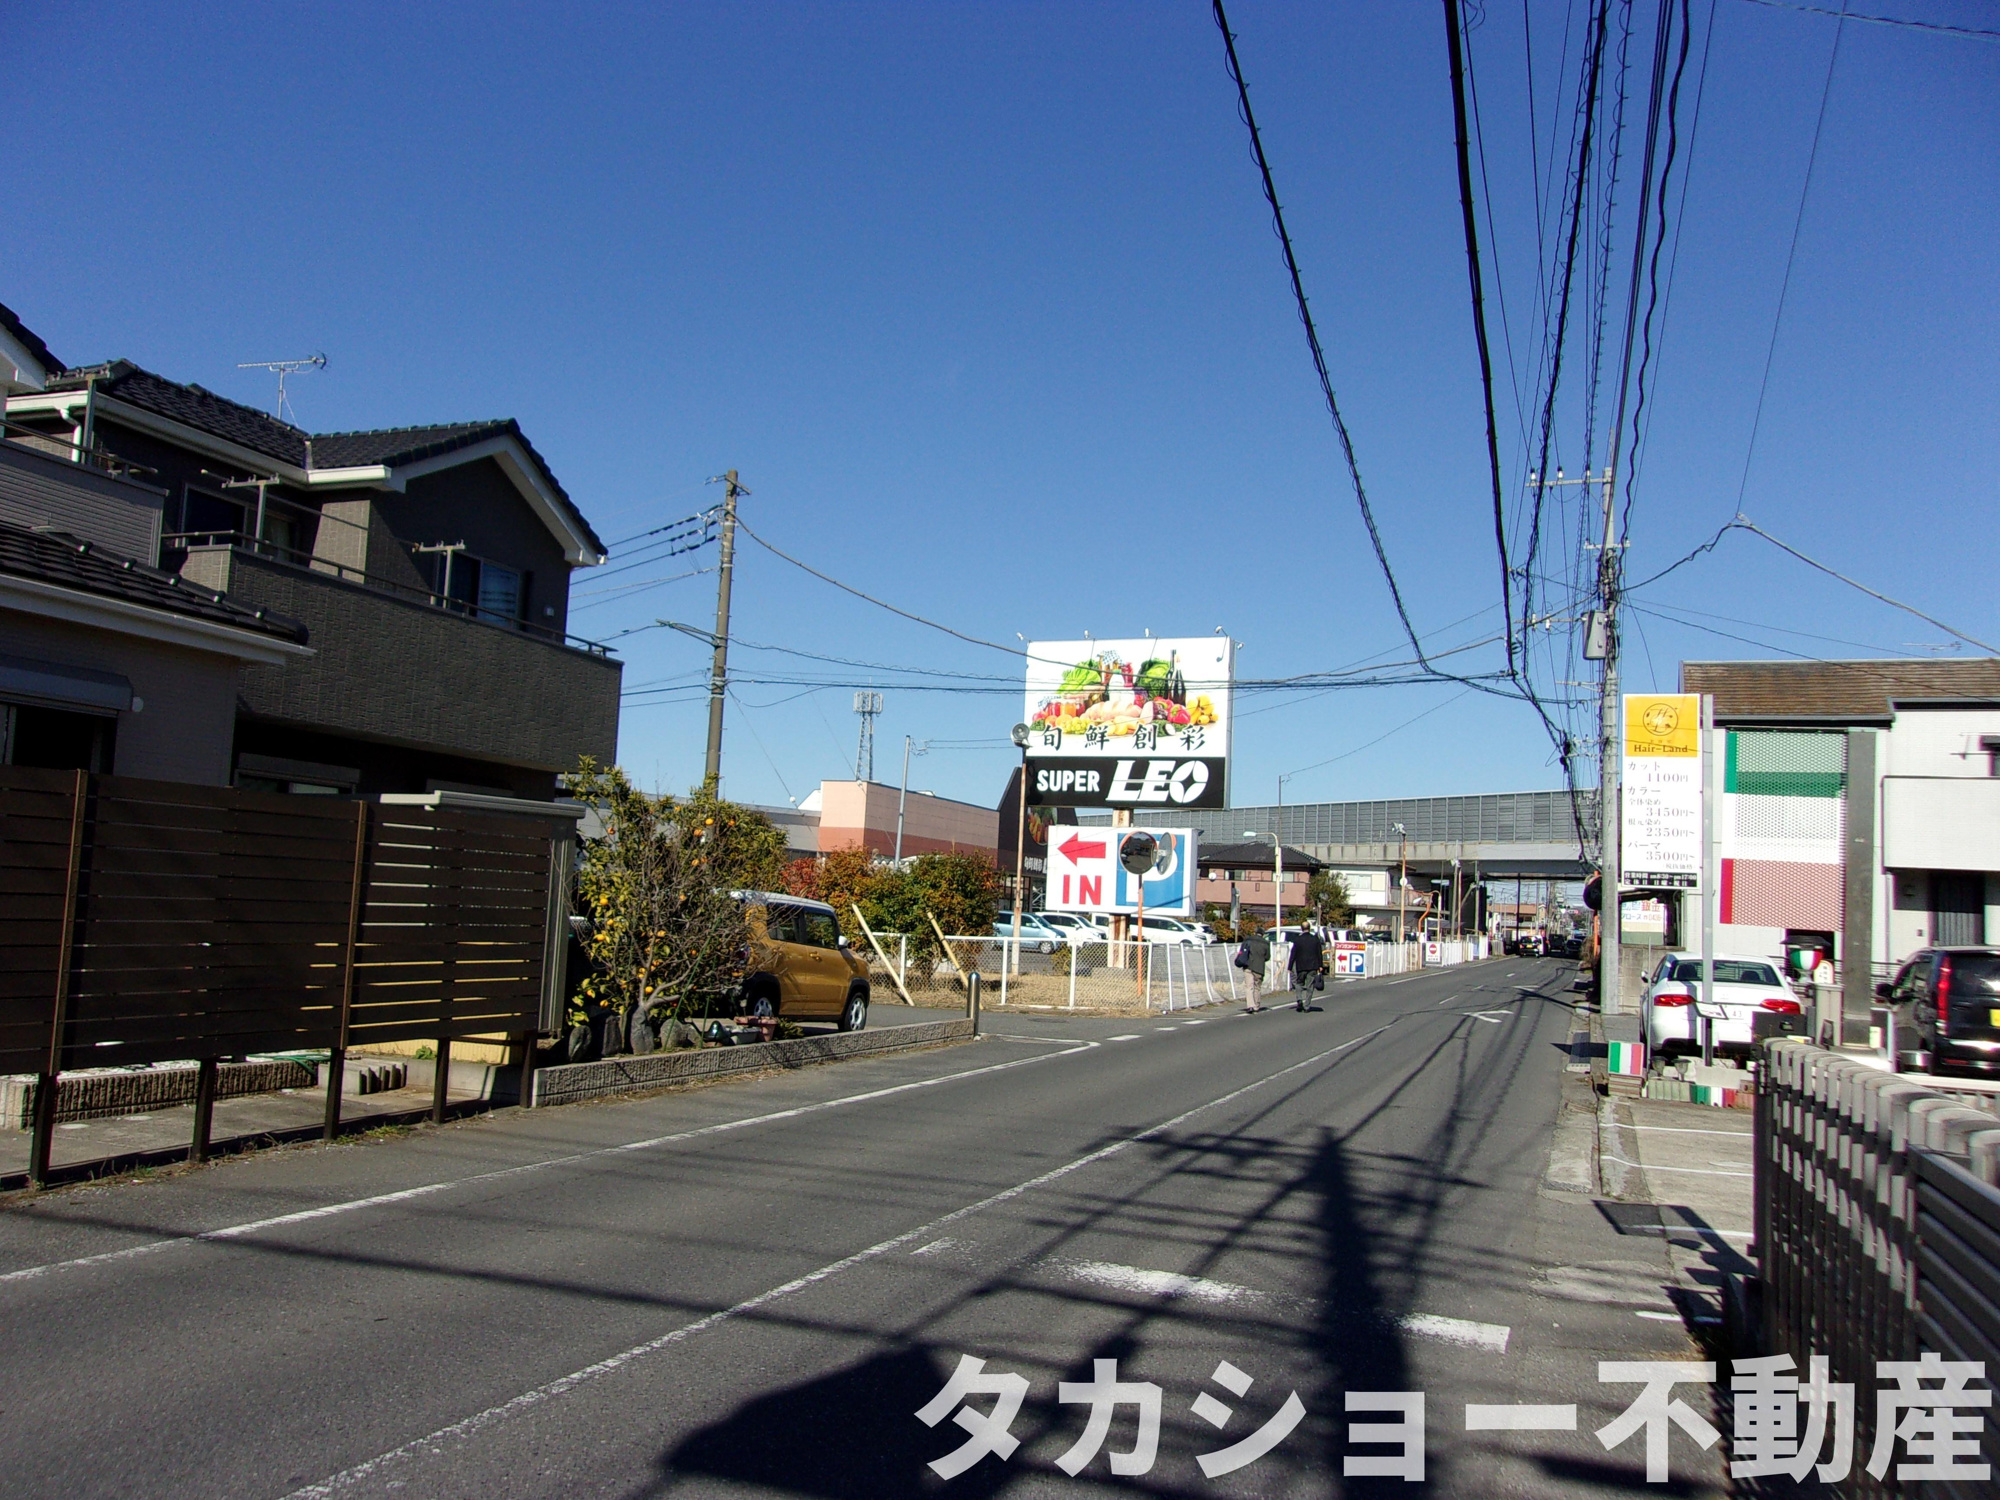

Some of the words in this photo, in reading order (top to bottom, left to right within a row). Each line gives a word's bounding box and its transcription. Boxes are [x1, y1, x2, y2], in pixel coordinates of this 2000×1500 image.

[1041, 724, 1206, 752] 旬鮮創彩
[1633, 744, 1688, 752] Hair-Land
[1628, 761, 1660, 771] カット
[1036, 769, 1101, 793] SUPER
[1105, 759, 1209, 803] LEO
[1627, 786, 1661, 795] カラー
[1062, 875, 1102, 905] IN
[1351, 954, 1363, 972] P
